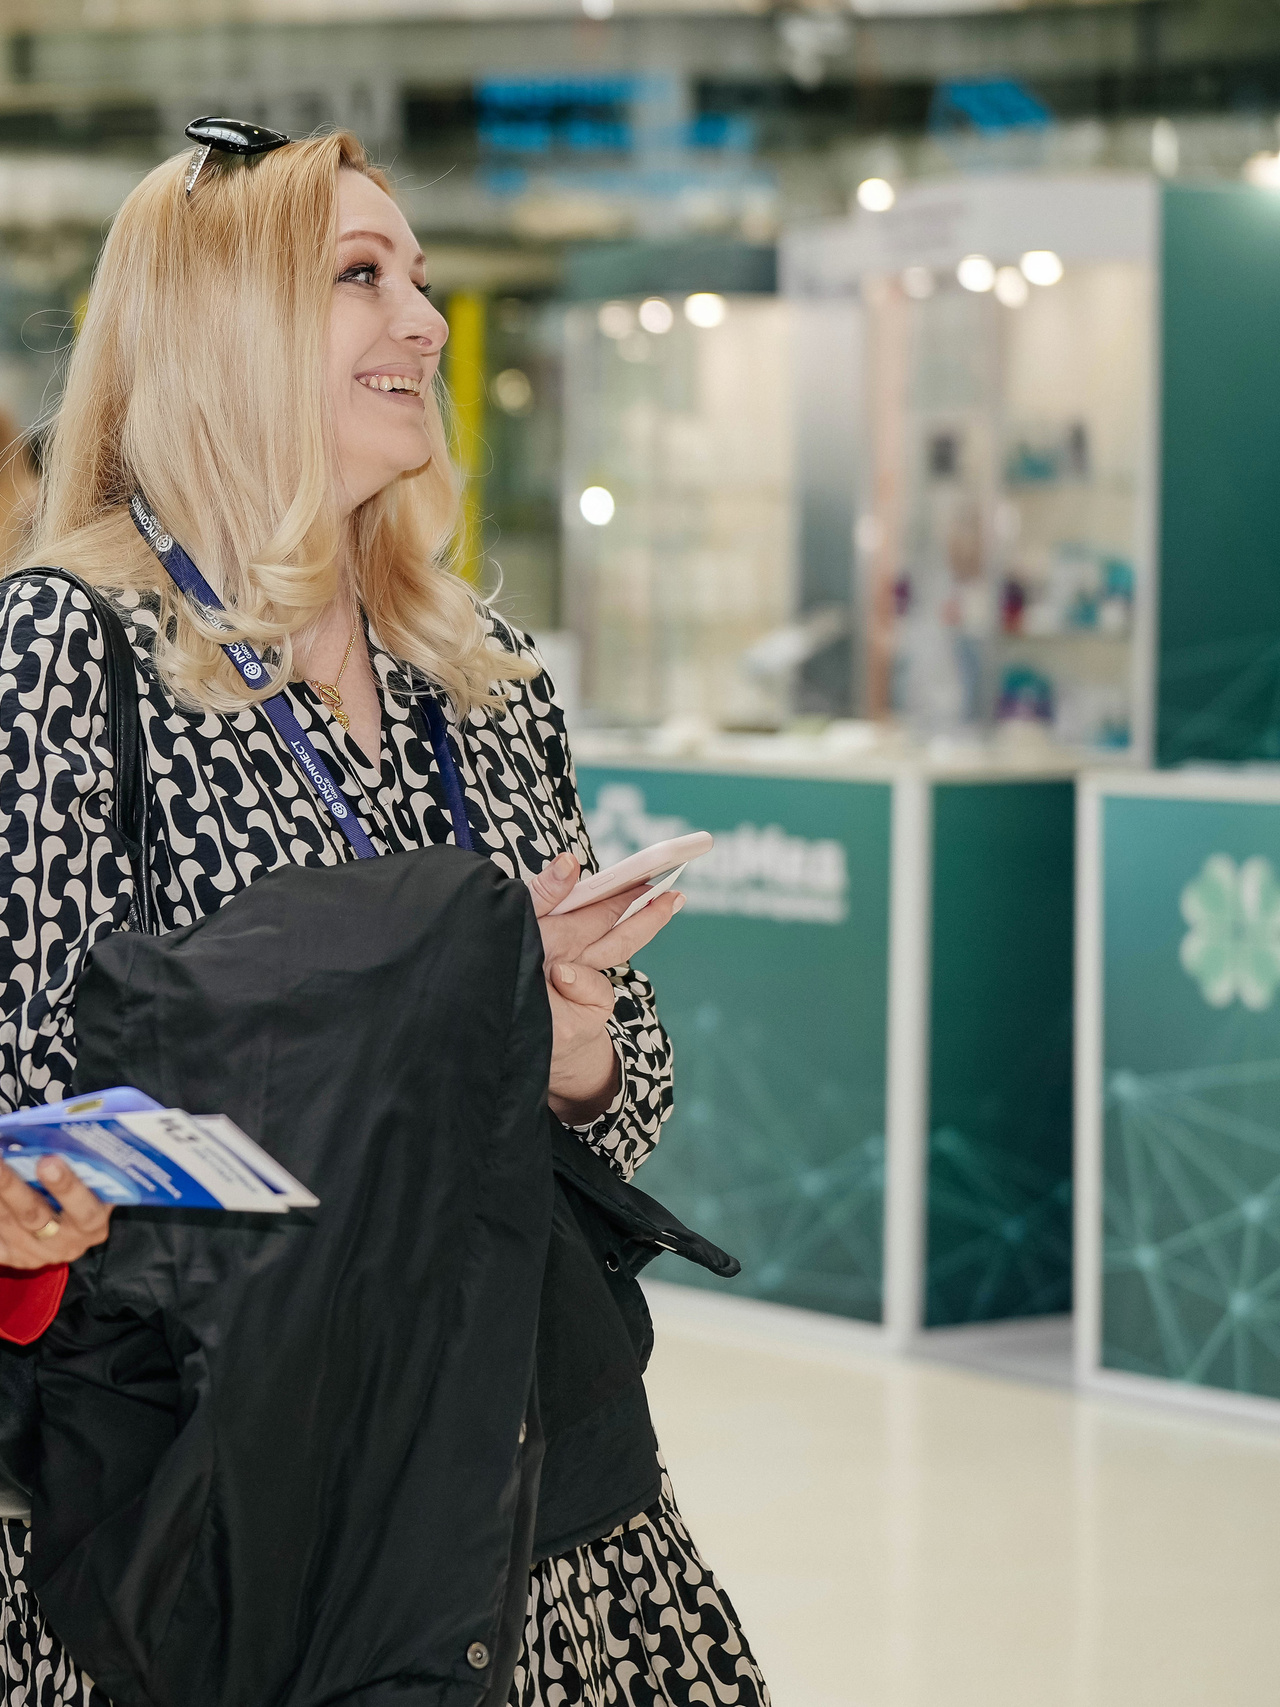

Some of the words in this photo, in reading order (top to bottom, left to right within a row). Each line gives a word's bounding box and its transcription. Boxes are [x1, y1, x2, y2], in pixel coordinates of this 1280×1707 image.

[238, 640, 253, 659] GROU
[291, 740, 335, 803] INCONNECT
[323, 777, 338, 799] GROUP
